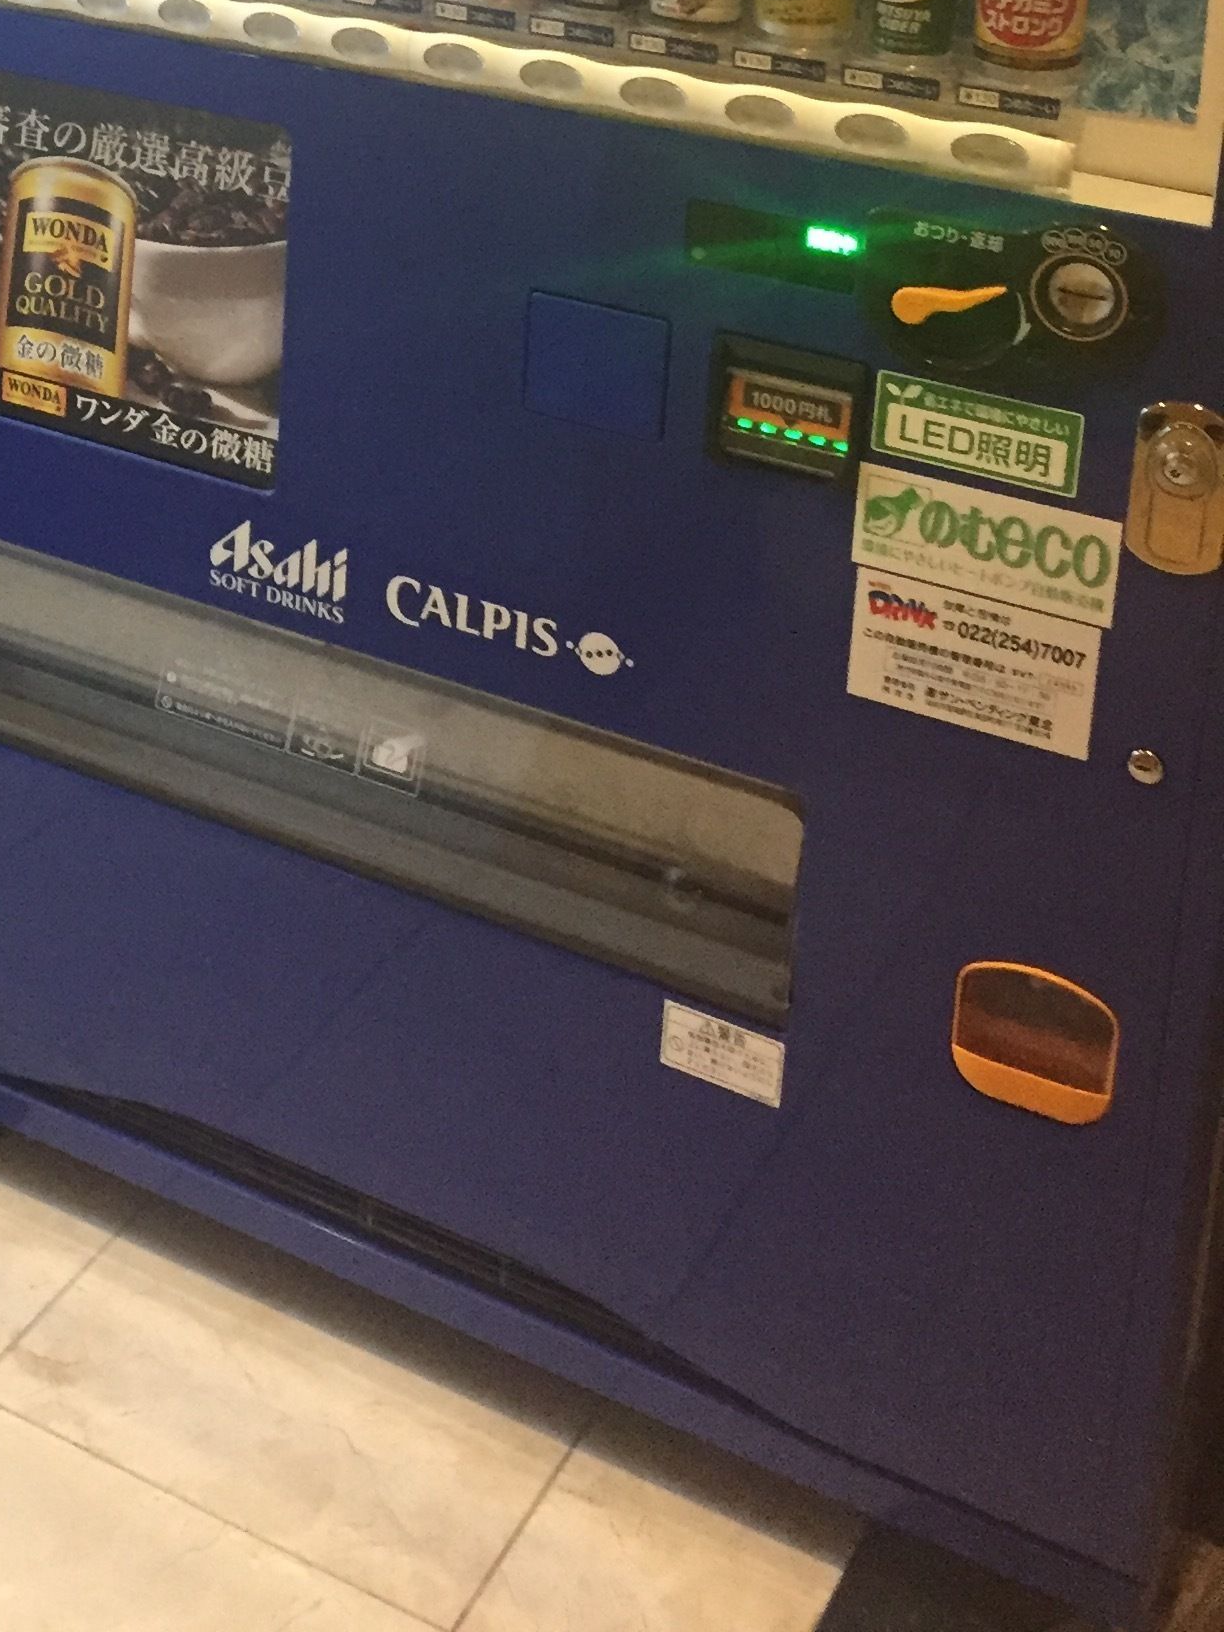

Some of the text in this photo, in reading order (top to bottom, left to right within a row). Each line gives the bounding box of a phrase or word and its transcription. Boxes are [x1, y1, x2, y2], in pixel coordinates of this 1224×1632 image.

[984, 9, 1064, 37] ストロング
[31, 215, 110, 254] WONDA
[913, 220, 1005, 254] おつり・返却
[24, 270, 107, 311] GOLD
[15, 294, 110, 335] QUALITY
[16, 334, 106, 382] 金の微糖
[7, 377, 64, 407] WONDA
[749, 389, 835, 425] 1000円札
[74, 395, 276, 475] ワンダ金の微糖
[898, 413, 1052, 478] LED照明
[208, 519, 350, 602] Asahi
[208, 568, 346, 624] SOFT DRINKS
[385, 574, 560, 657] CALPIS
[956, 621, 1088, 670] 022(254)7007
